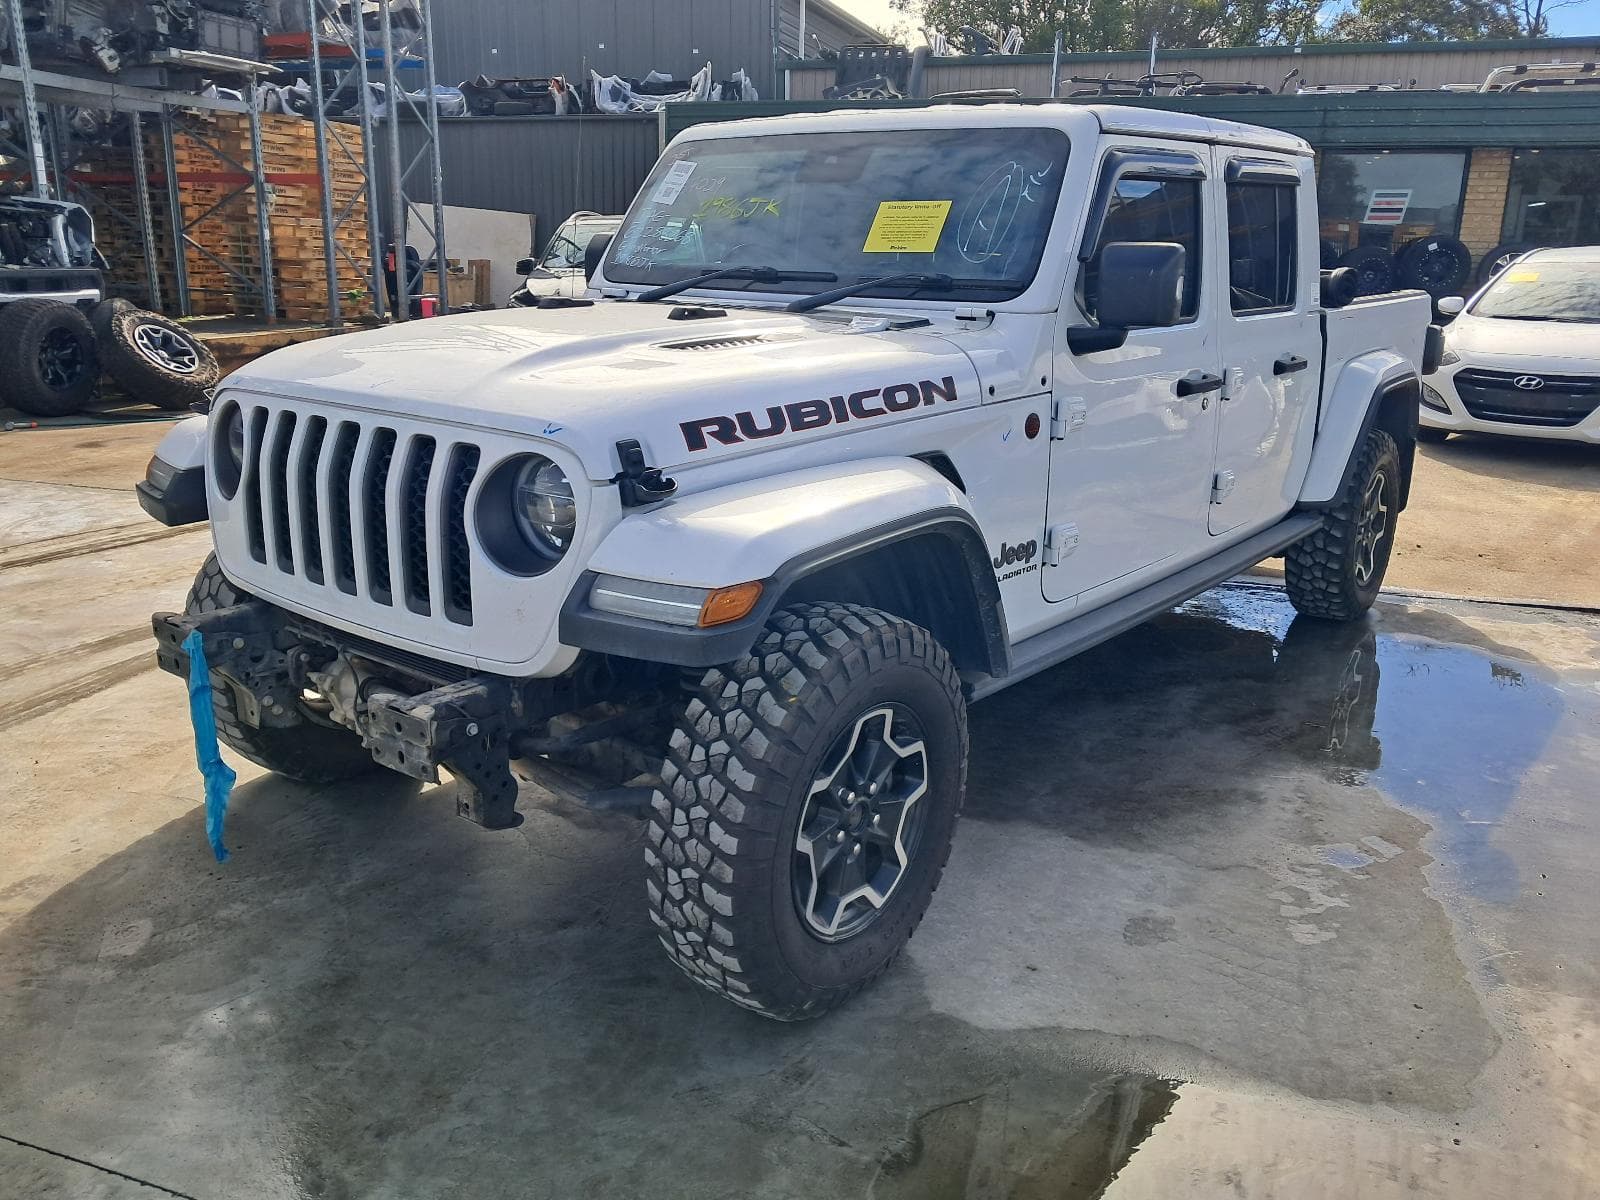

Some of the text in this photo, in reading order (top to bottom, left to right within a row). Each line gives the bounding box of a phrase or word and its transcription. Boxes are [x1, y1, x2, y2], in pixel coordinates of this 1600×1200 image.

[679, 375, 958, 452] RUBICON
[993, 539, 1037, 569] Jeep
[996, 563, 1038, 583] LADIATOR
